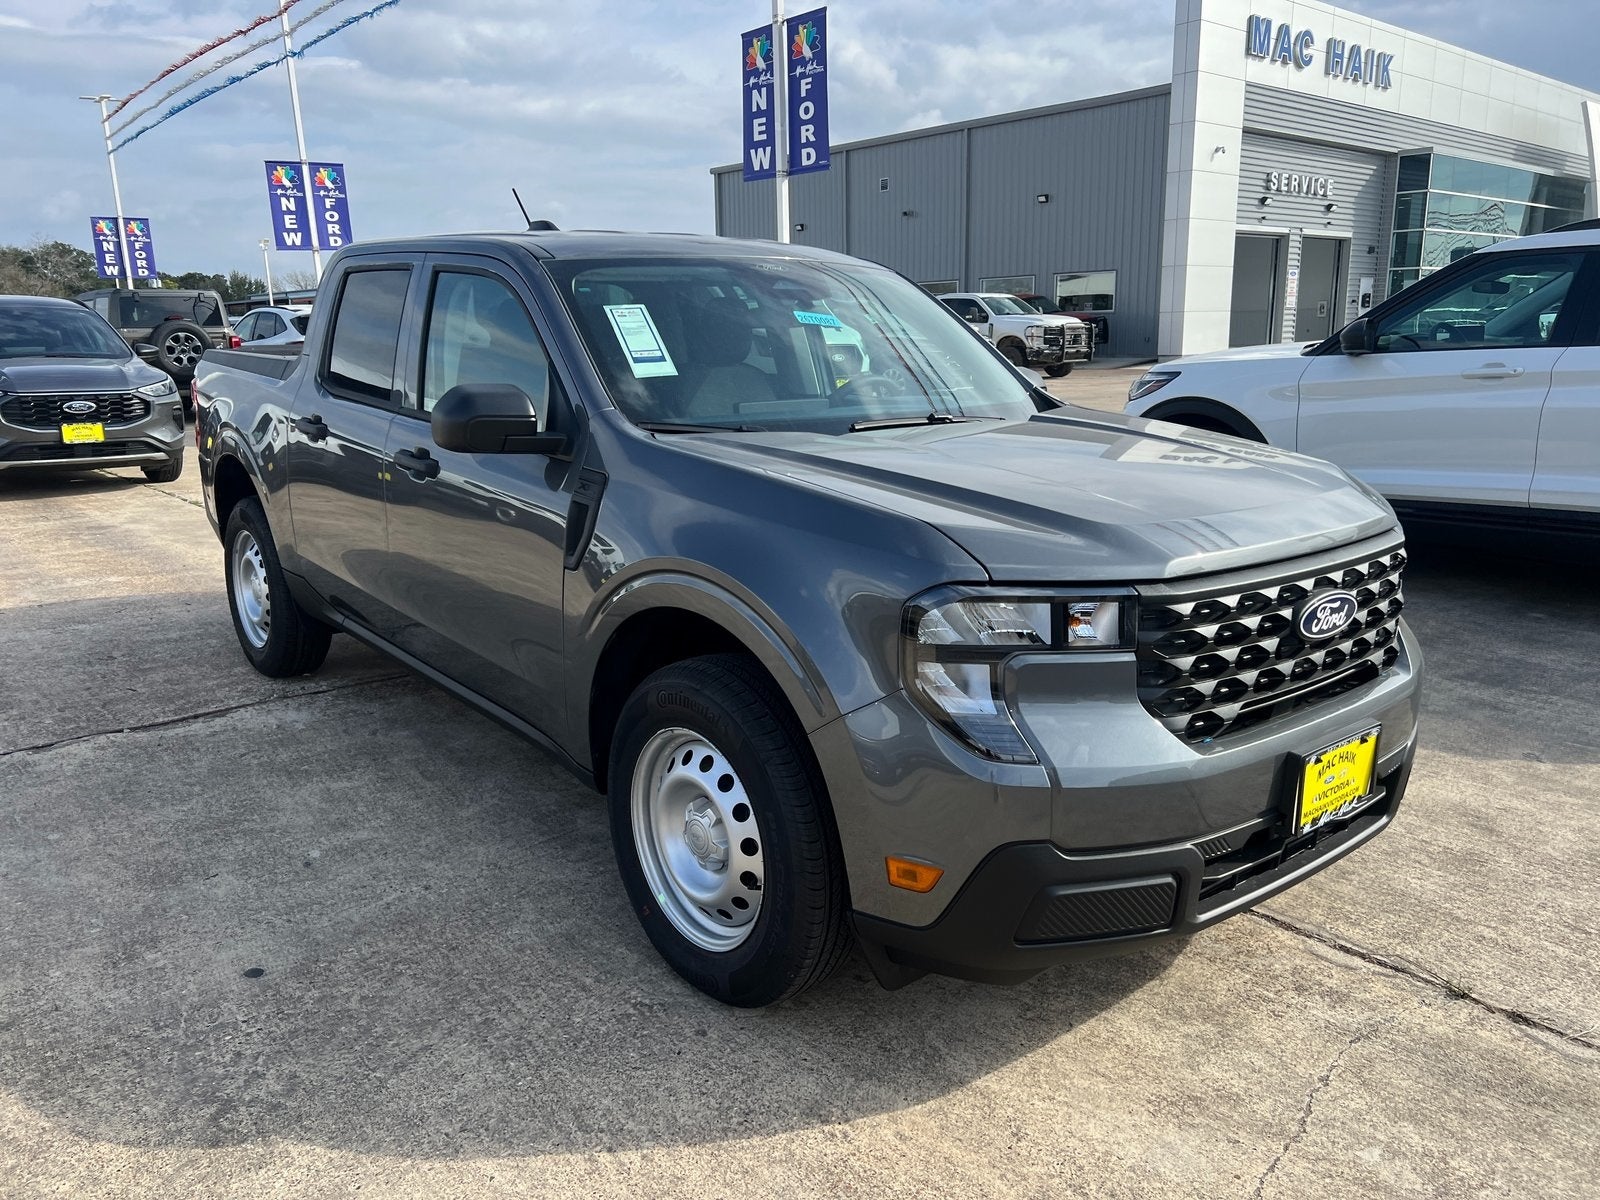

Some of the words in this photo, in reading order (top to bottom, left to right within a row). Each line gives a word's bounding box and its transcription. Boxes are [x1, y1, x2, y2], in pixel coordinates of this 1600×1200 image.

[1246, 14, 1315, 69] MAC
[1325, 37, 1395, 89] HAIK
[750, 87, 772, 171] NEW
[799, 77, 816, 167] FORD
[1265, 171, 1336, 198] SERVICE
[280, 196, 302, 246] NEW
[324, 198, 343, 247] FORD
[102, 241, 119, 276] NEW
[134, 242, 149, 276] FORD
[1311, 600, 1349, 633] Ford
[1317, 754, 1338, 782] MAC
[1338, 750, 1357, 766] HAIK
[1317, 780, 1351, 802] VICTORIA
